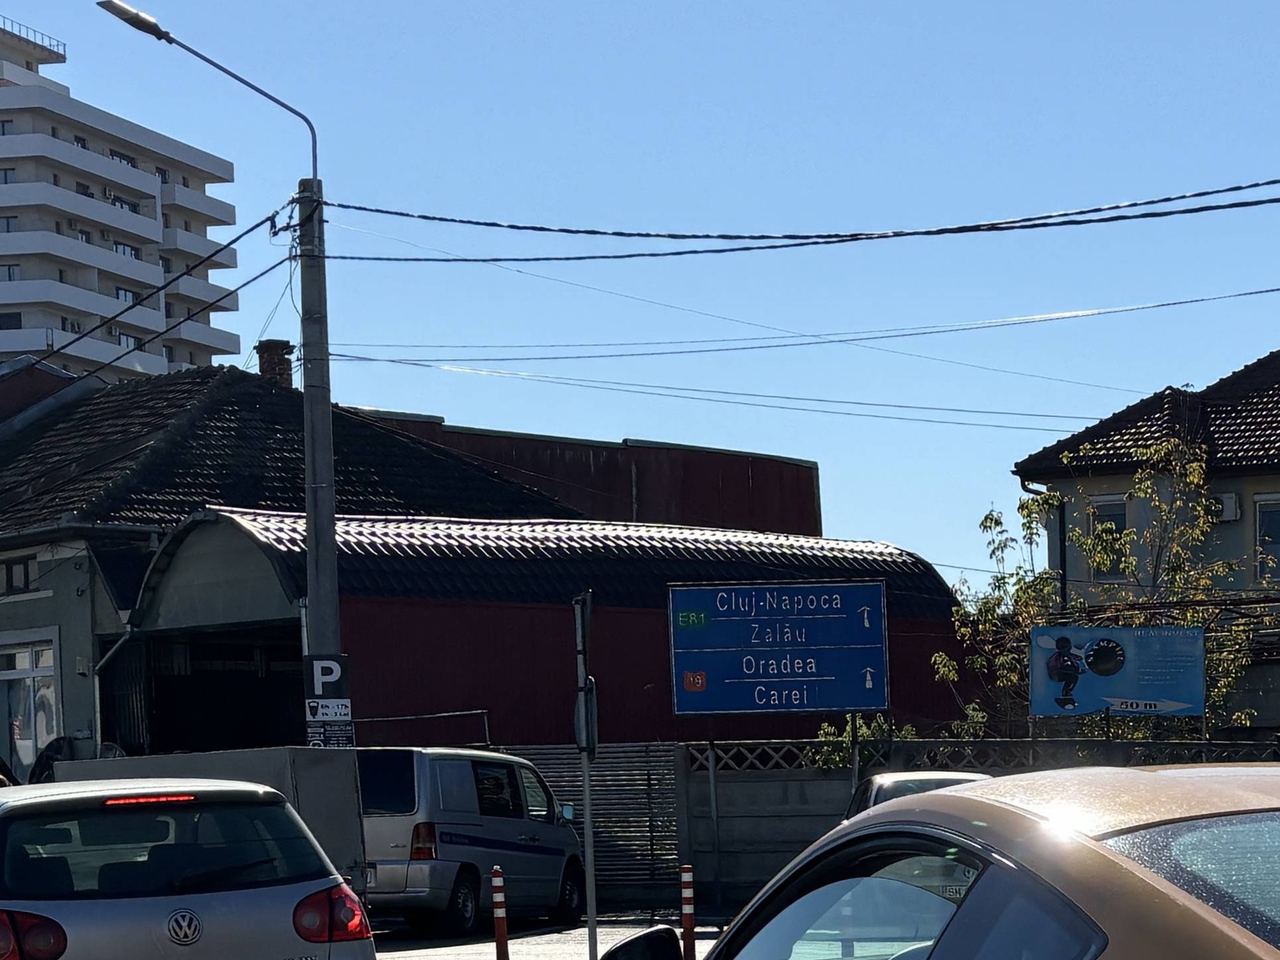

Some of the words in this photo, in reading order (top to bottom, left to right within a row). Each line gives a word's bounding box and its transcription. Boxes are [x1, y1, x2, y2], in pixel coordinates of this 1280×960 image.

[716, 591, 841, 615] Cluj-Napoca
[679, 612, 706, 626] E81
[742, 654, 817, 674] Oradea
[313, 660, 342, 695] P
[754, 685, 808, 705] Carei
[1120, 701, 1139, 710] 50
[1143, 702, 1157, 710] m
